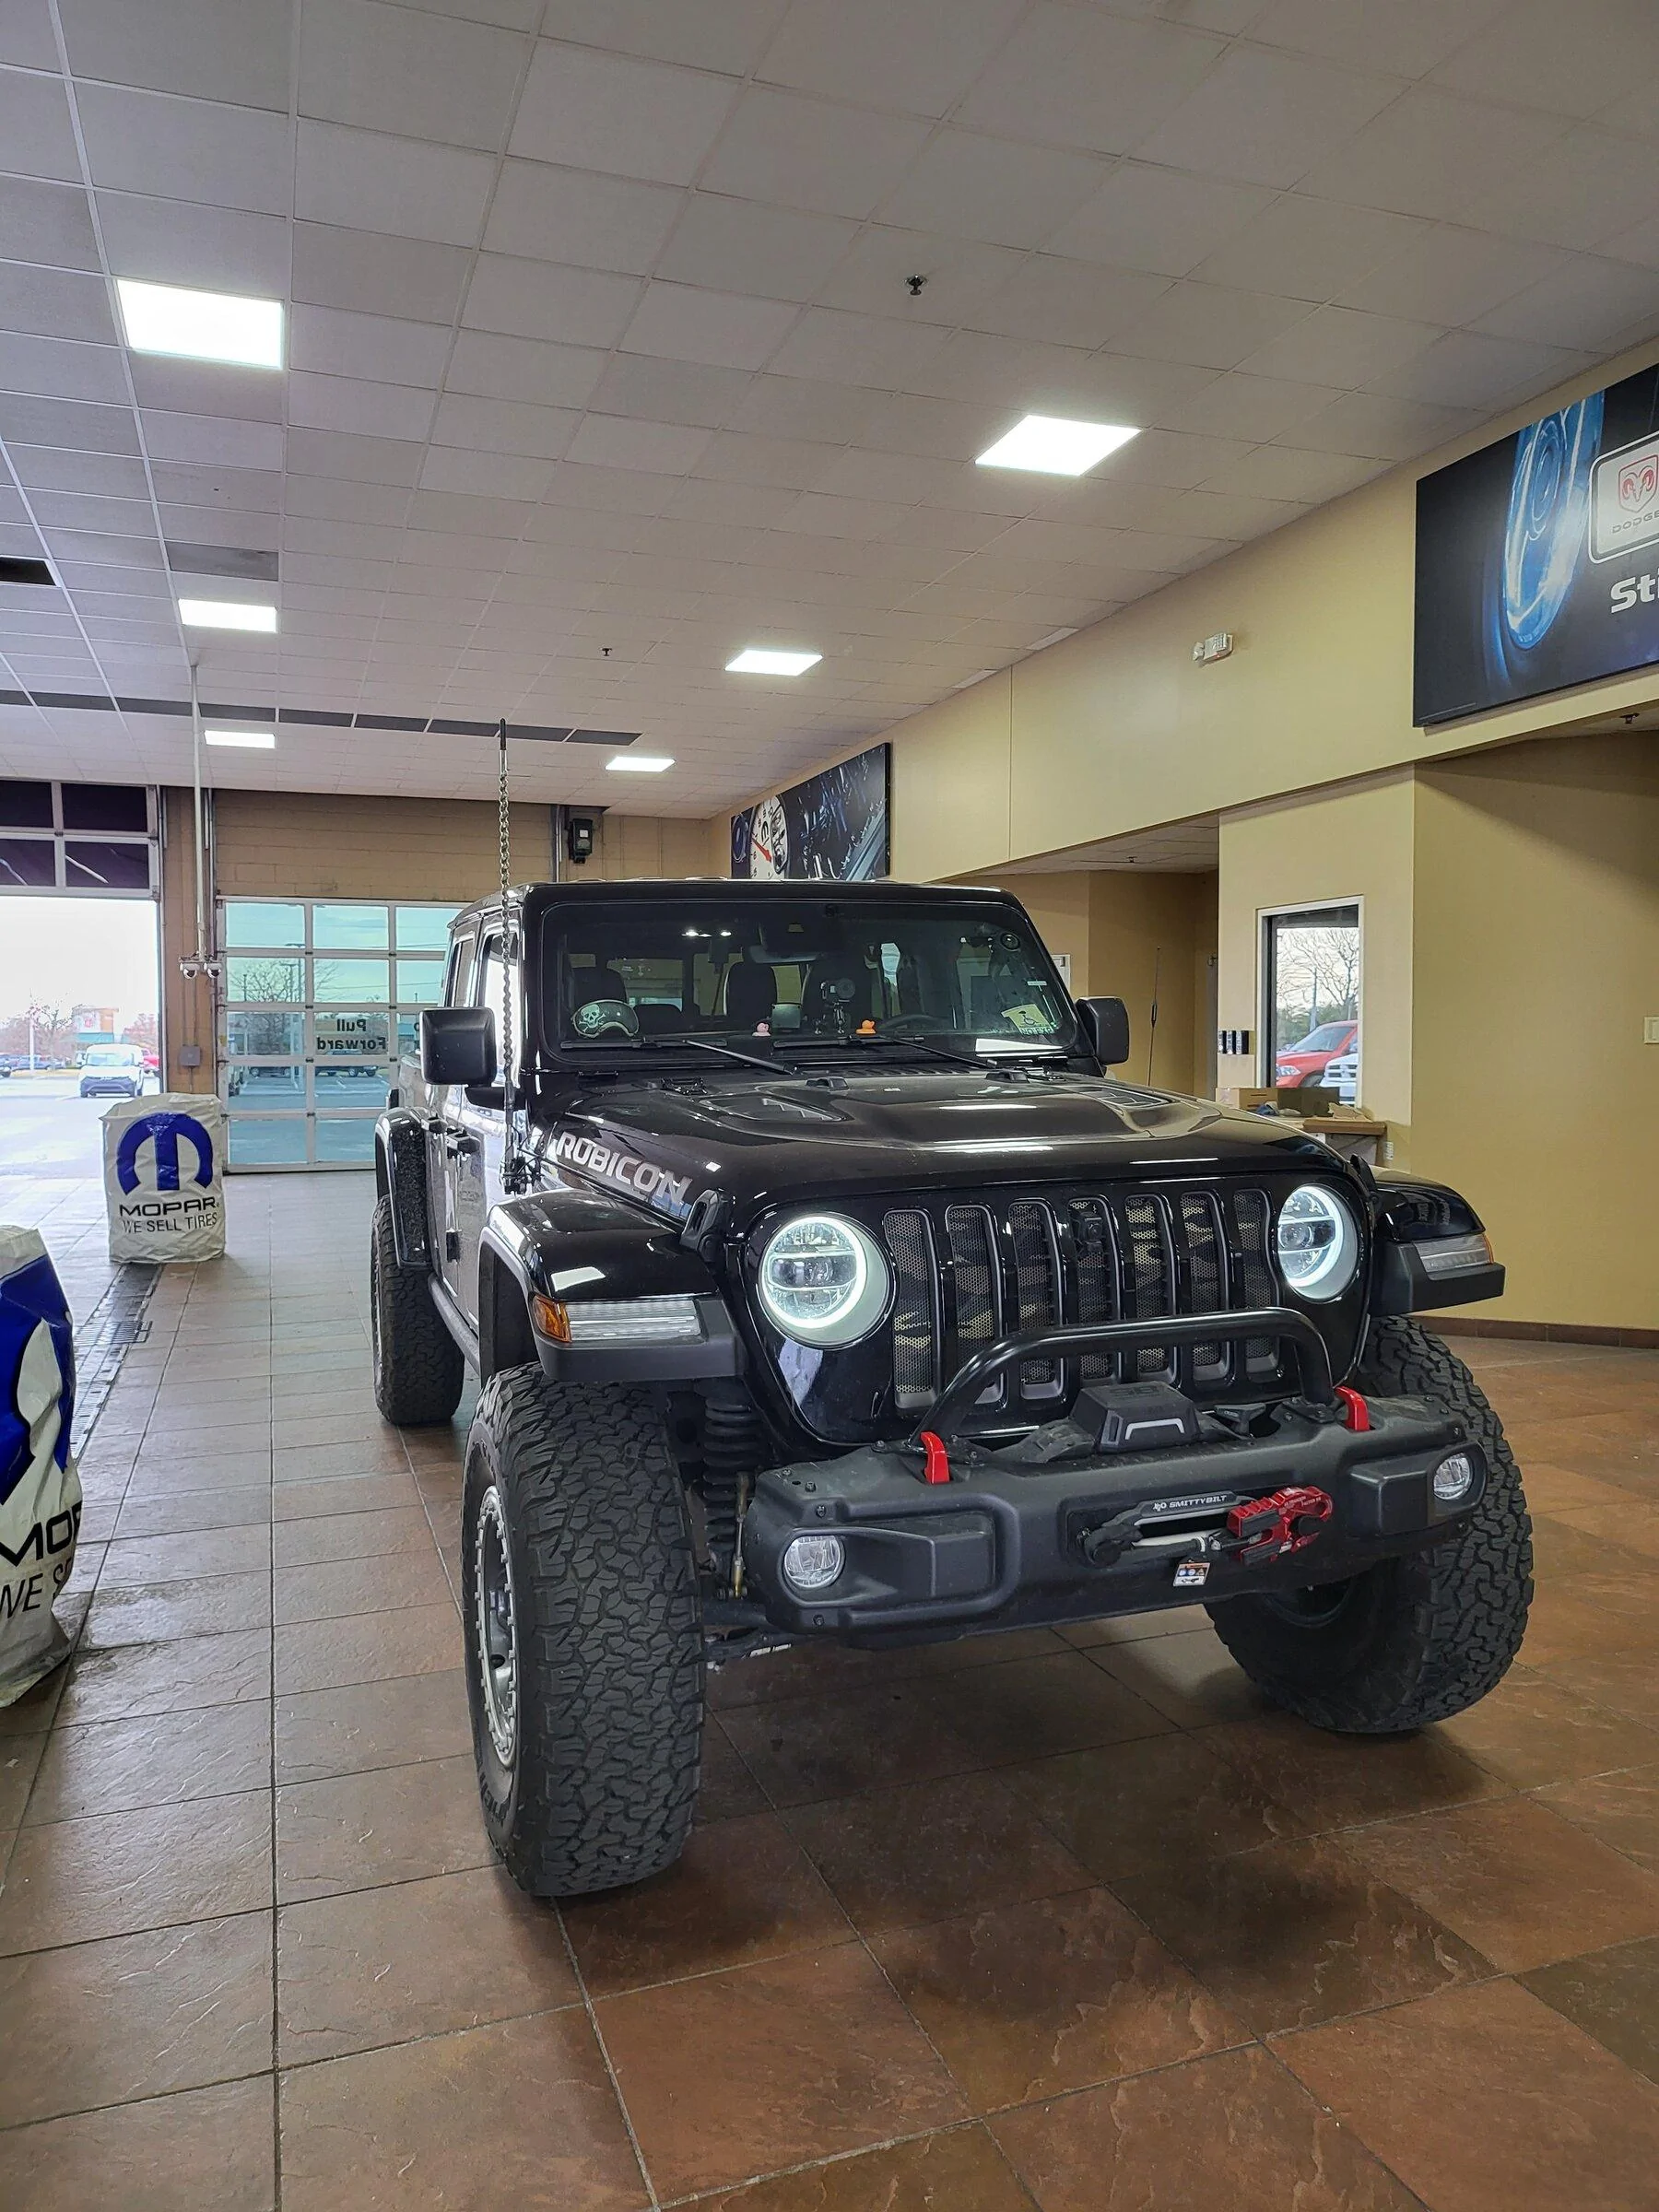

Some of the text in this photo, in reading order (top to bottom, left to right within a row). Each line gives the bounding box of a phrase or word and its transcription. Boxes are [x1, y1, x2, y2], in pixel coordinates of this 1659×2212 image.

[1610, 568, 1659, 614] St
[556, 1131, 693, 1204] RUBICON
[119, 1196, 217, 1217] MOPAR
[123, 1212, 218, 1234] WE SELL TIRES
[1169, 1495, 1227, 1509] SMITTYBILT
